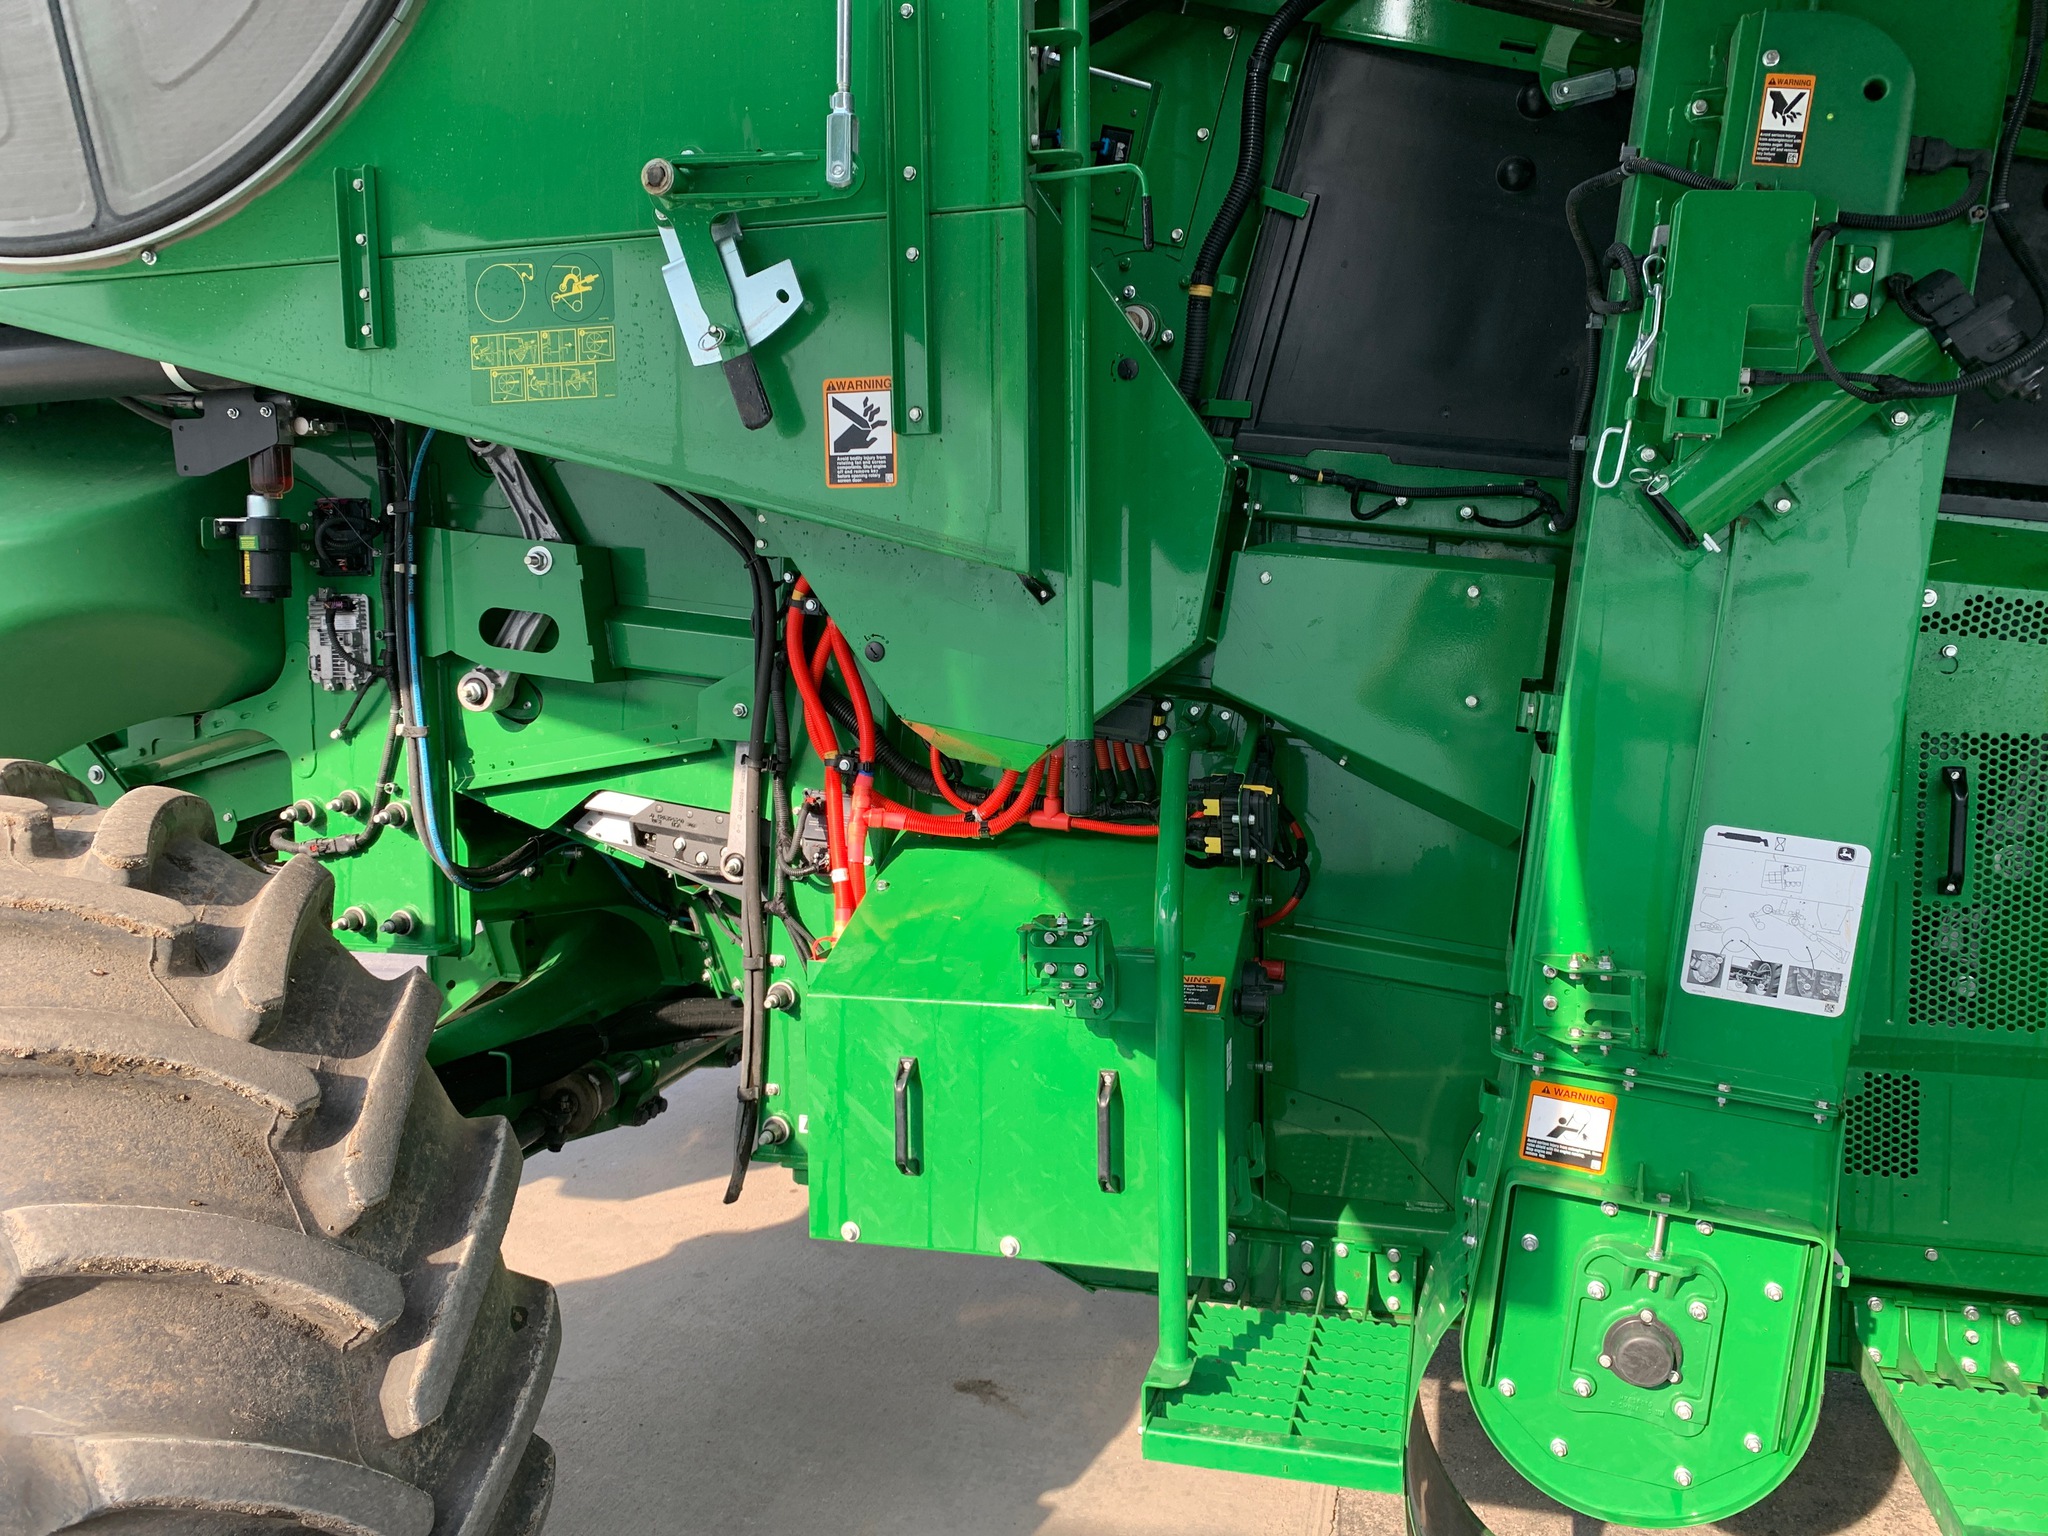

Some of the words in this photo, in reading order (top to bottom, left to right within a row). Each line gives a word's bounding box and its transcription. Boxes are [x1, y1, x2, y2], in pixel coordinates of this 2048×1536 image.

[1777, 78, 1811, 87] WARNING
[836, 378, 892, 390] WARNING
[1554, 1087, 1605, 1105] WARNING
